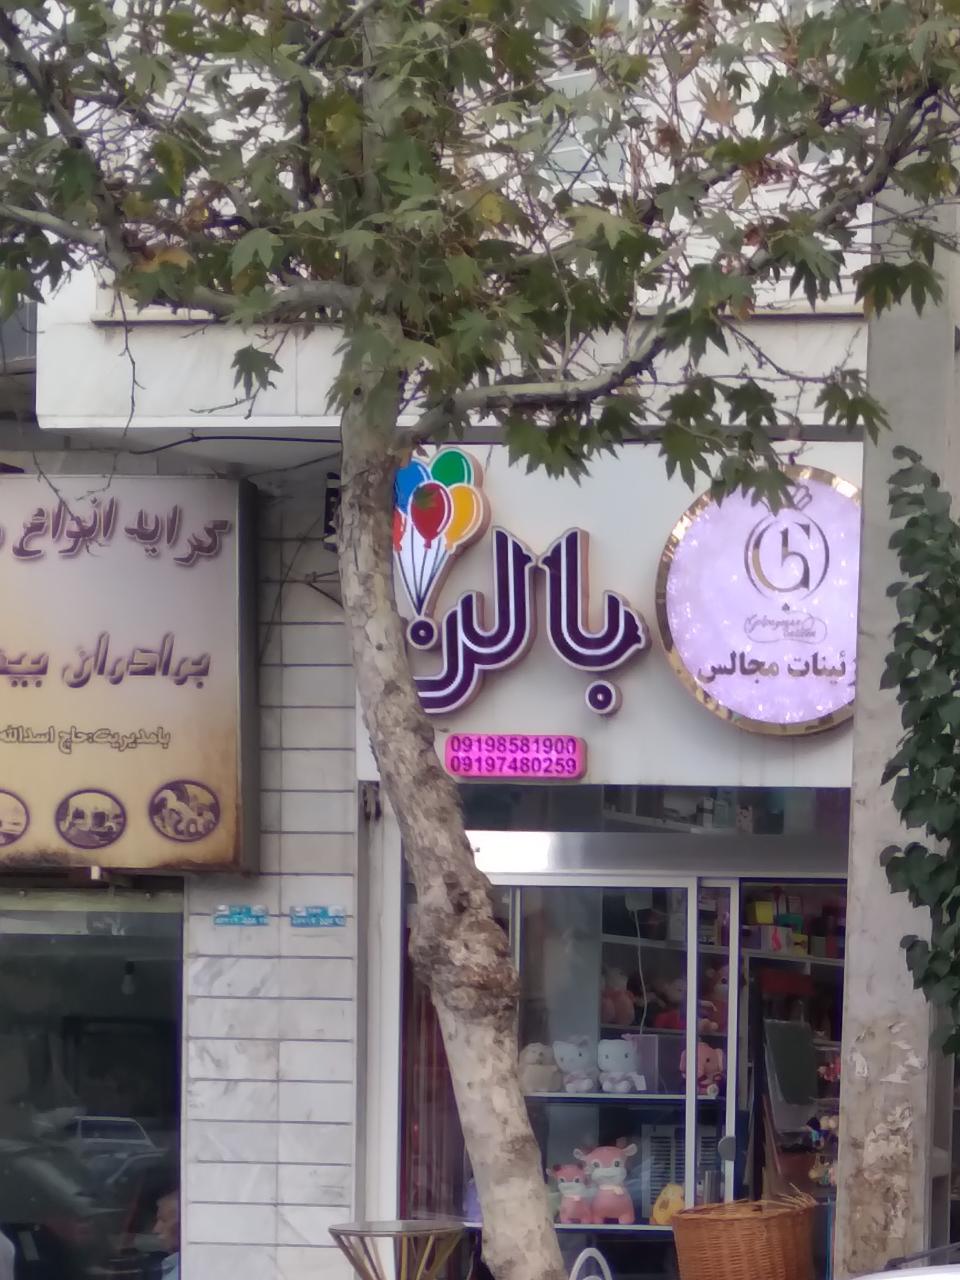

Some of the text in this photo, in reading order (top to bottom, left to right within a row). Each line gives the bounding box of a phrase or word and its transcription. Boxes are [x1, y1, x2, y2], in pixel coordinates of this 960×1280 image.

[13, 496, 119, 560] انواع
[62, 631, 211, 689] برادران
[698, 651, 780, 684] مجالس
[450, 735, 577, 755] 09198581900
[450, 755, 577, 774] 09197480259
